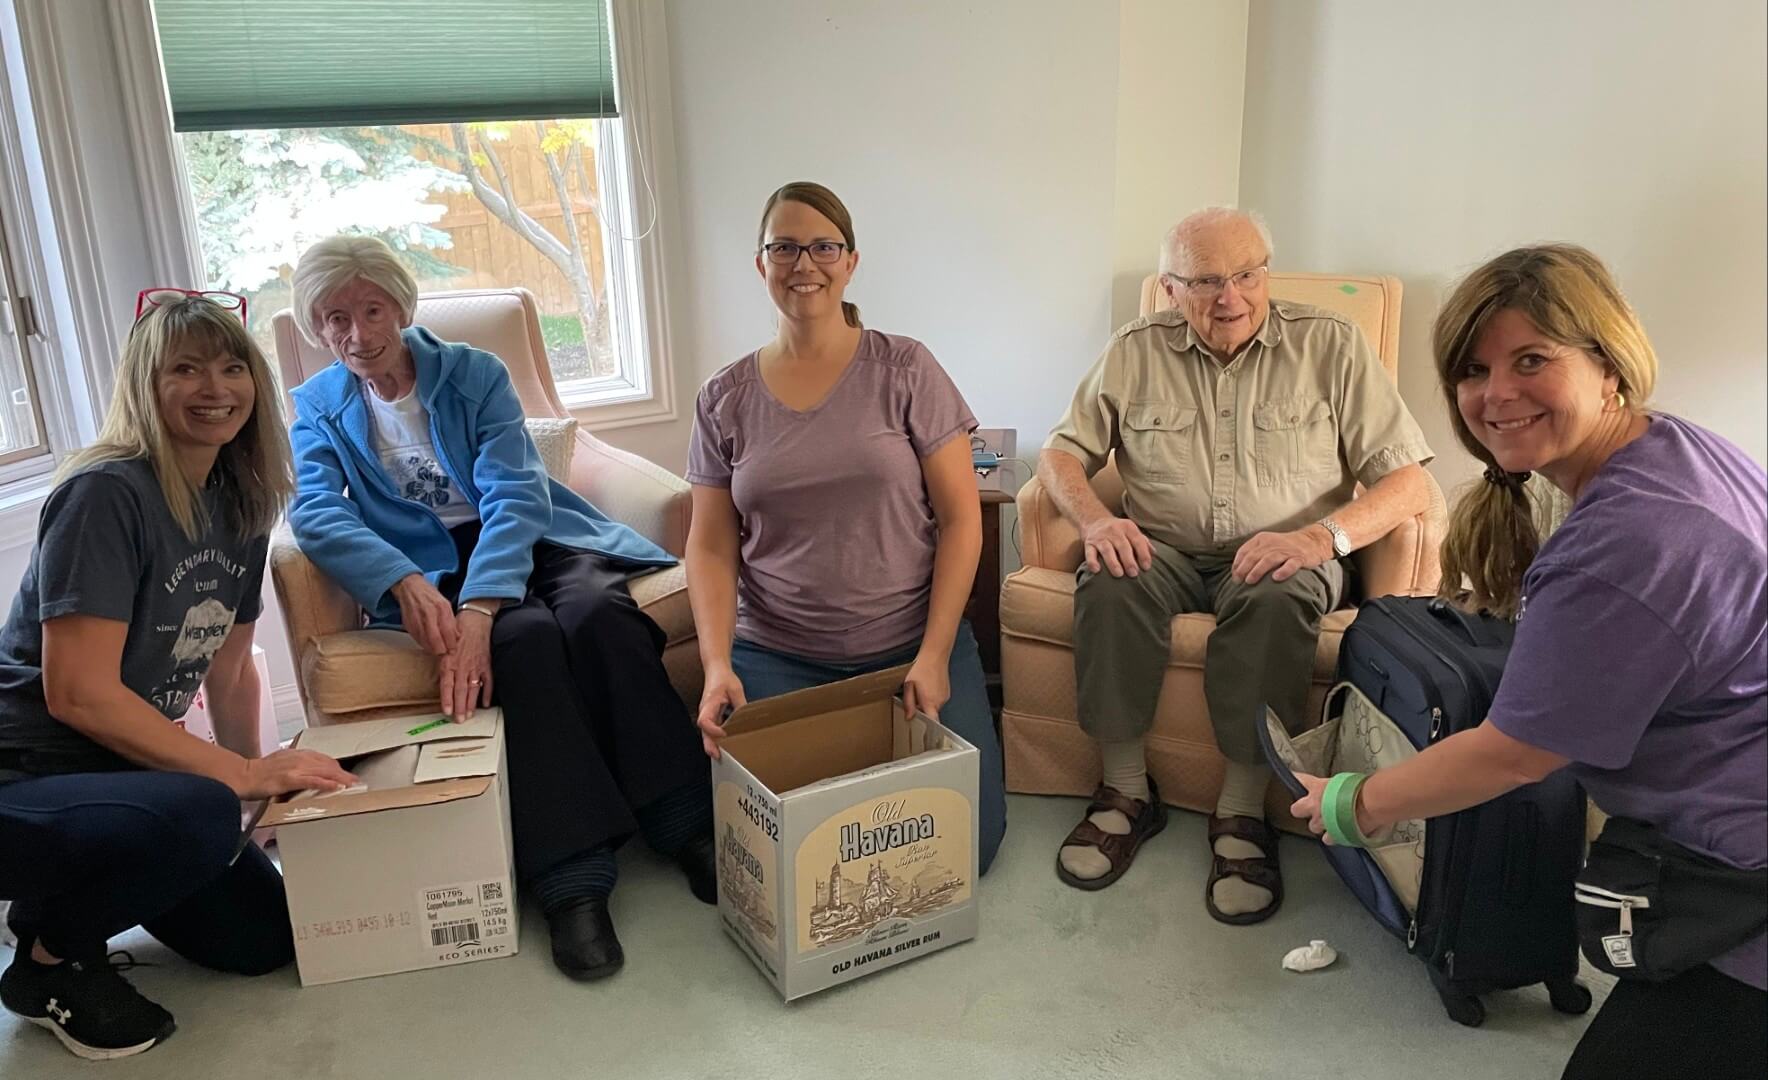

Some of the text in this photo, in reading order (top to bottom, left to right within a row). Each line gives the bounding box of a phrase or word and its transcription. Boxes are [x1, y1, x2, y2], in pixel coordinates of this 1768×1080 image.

[164, 548, 216, 594] LEGENDARY
[758, 794, 768, 810] 750
[871, 799, 906, 826] Old
[840, 813, 934, 863] Havana
[832, 961, 851, 975] OLD
[854, 947, 893, 967] HAVANA
[894, 938, 921, 953] SILVER
[923, 930, 941, 944] RUM
